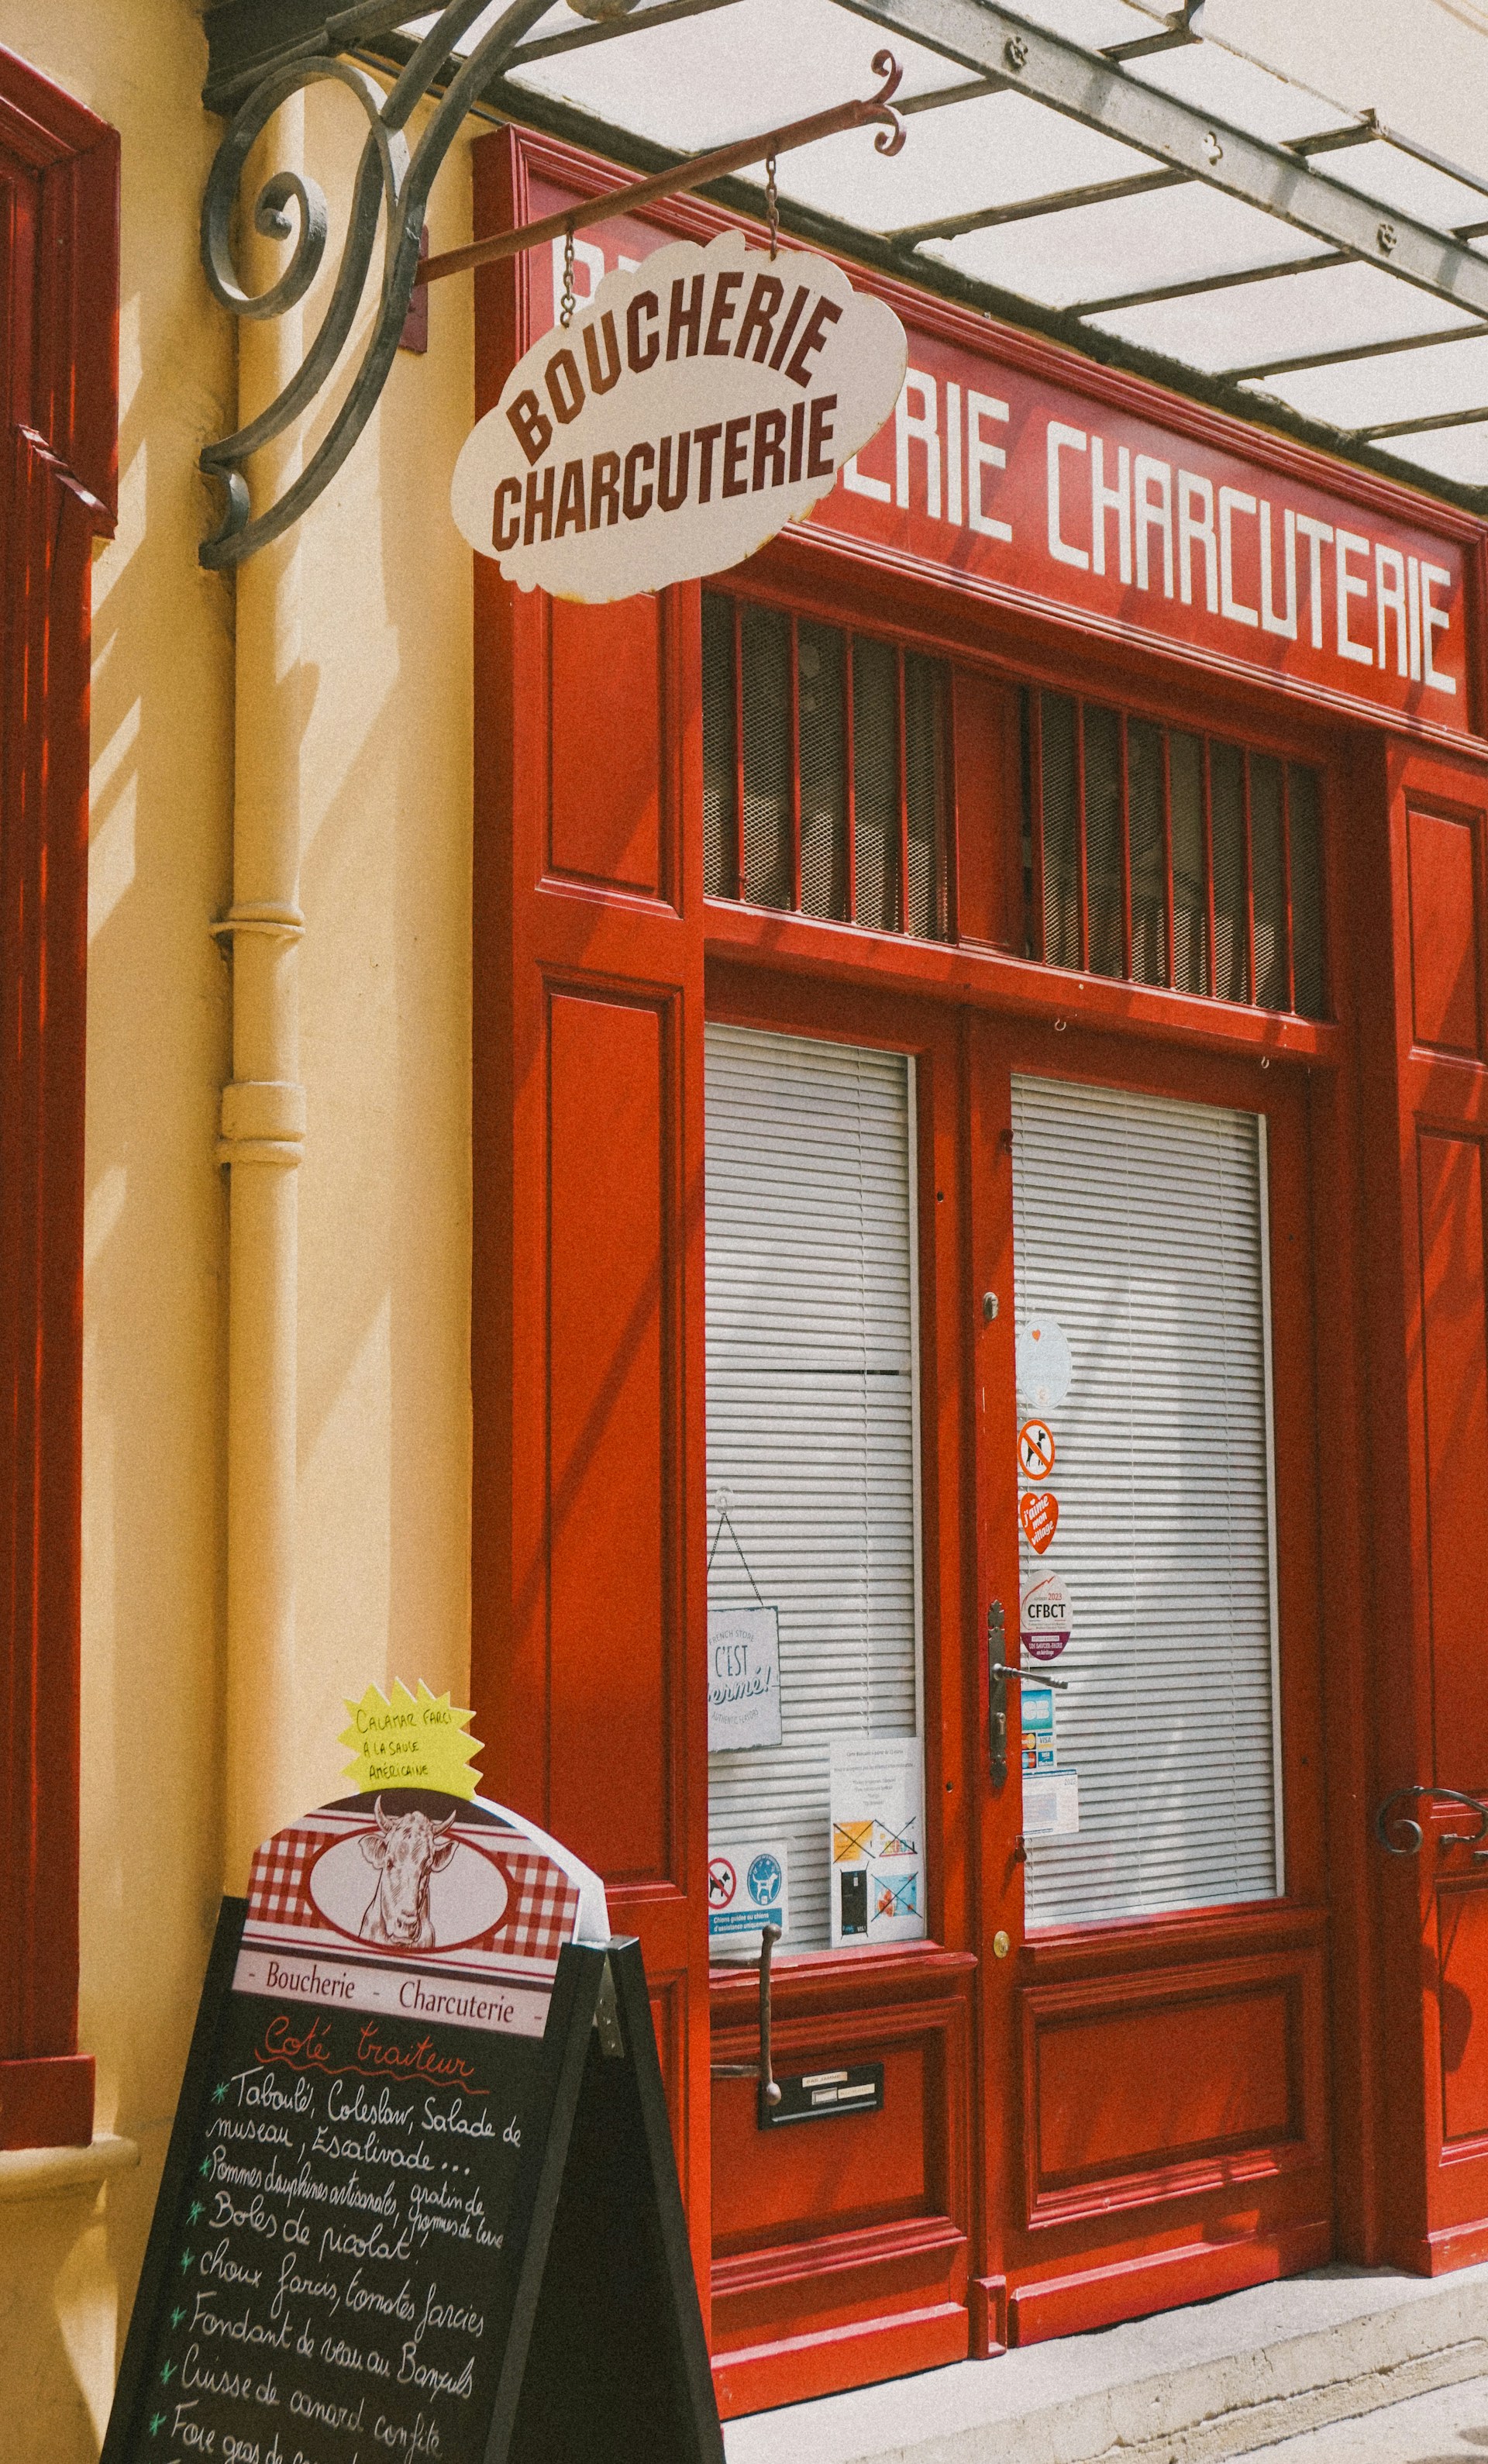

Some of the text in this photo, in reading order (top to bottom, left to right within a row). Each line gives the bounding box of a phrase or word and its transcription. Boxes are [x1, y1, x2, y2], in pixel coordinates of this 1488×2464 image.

[506, 271, 843, 466] BOUCHERIE
[491, 393, 838, 552] CHARCUTERIE
[1046, 420, 1457, 695] CHARCUTERIE
[1024, 1495, 1049, 1528] j'aime
[1031, 1520, 1054, 1546] village
[1032, 1511, 1048, 1530] mon
[1028, 1604, 1066, 1618] CFBCT
[709, 1629, 754, 1646] FRENCH STORE
[715, 1645, 748, 1677] C'EST
[356, 1709, 452, 1733] CALAMAR FARCI
[711, 1711, 738, 1725] AUTHENTIC
[266, 1961, 515, 2024] Boucherie Charcuterie
[357, 2021, 474, 2076] traiteur
[421, 2096, 495, 2137] Salade
[502, 2116, 522, 2148] de
[208, 2145, 262, 2182] Pommes
[264, 2156, 329, 2207] dauphines
[409, 2180, 462, 2221] gratin
[465, 2186, 484, 2216] de
[208, 2190, 277, 2238] Boles
[283, 2208, 310, 2245] de
[458, 2214, 472, 2238] de
[200, 2238, 263, 2288] choux
[346, 2268, 415, 2321] tomates
[414, 2283, 484, 2342] farcies
[189, 2291, 474, 2403] Fondant de veau au Banyuls
[181, 2343, 252, 2397] Cuisse
[256, 2372, 281, 2405] de
[290, 2397, 364, 2432] canard
[222, 2435, 260, 2464] gras
